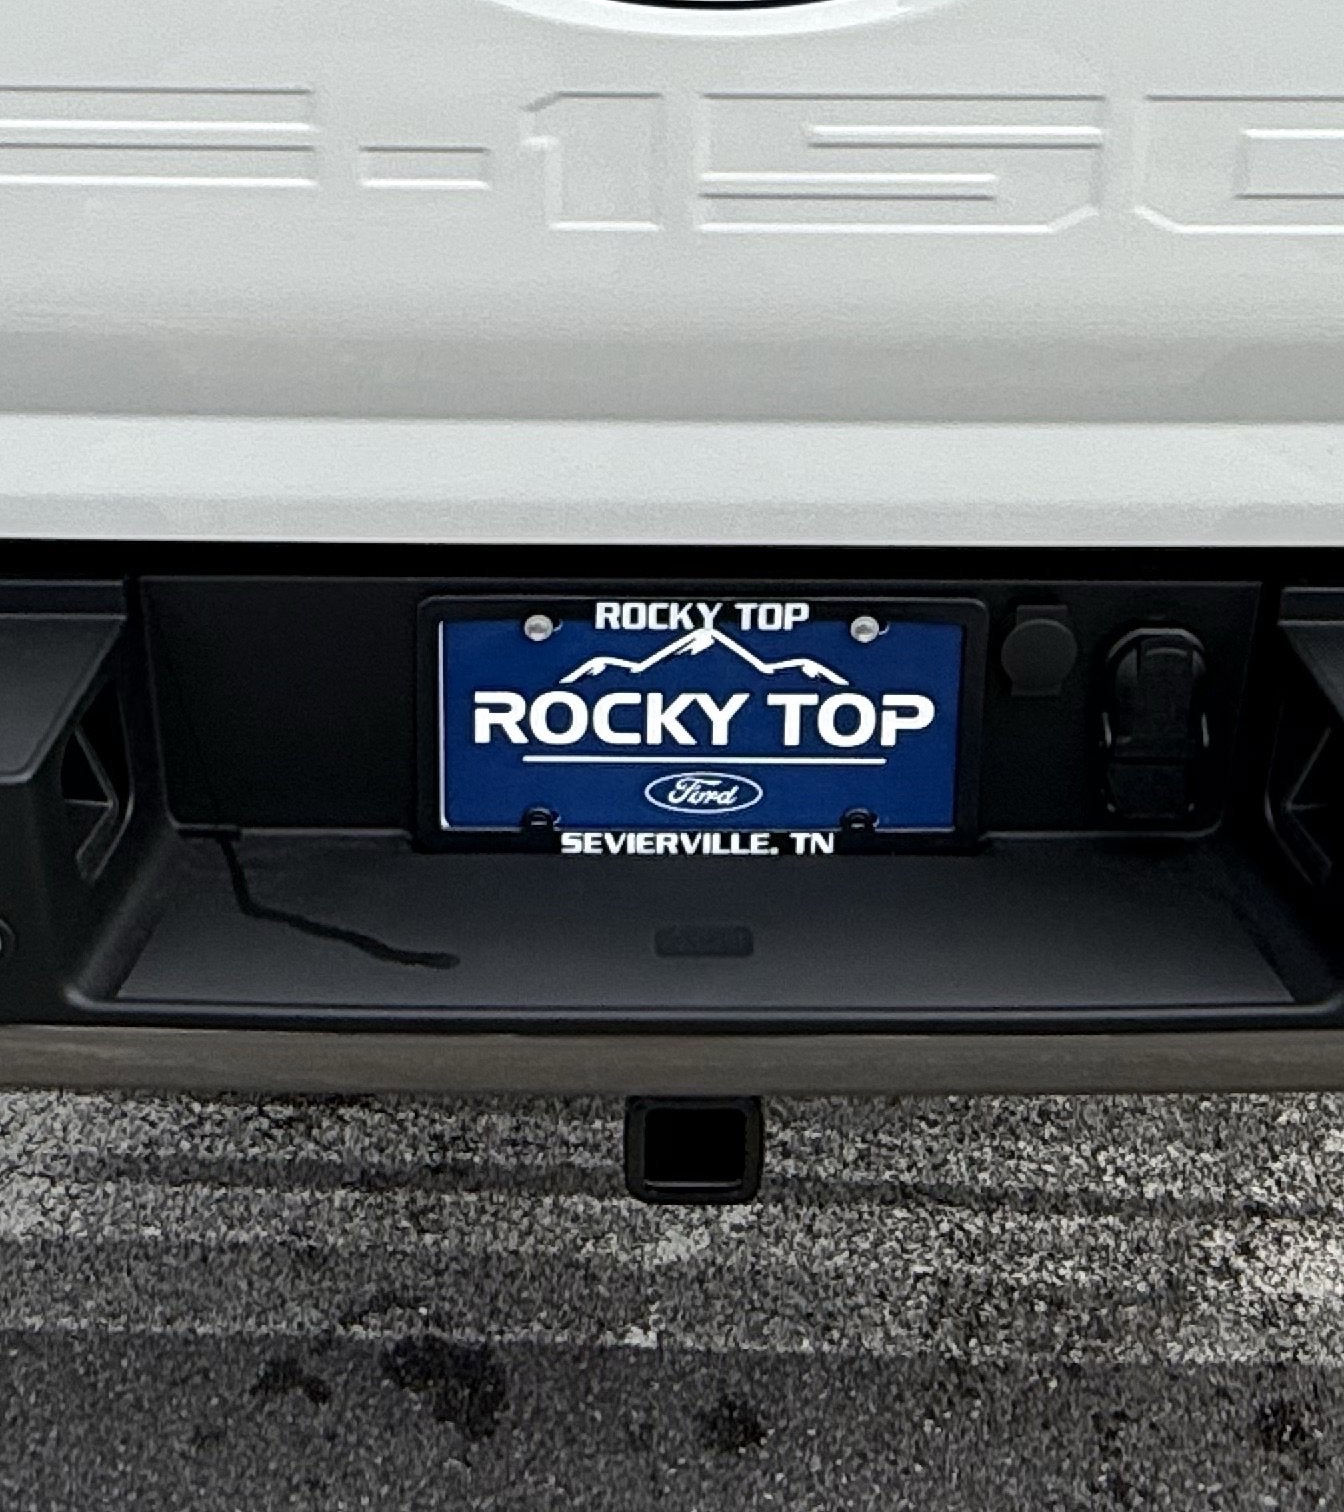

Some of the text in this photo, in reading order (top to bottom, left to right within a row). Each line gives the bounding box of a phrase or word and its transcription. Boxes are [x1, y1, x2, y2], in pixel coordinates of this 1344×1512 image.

[594, 601, 810, 631] ROCKY TOP
[473, 690, 937, 748] ROCKY TOP
[667, 776, 741, 808] Ford
[789, 832, 835, 856] TN
